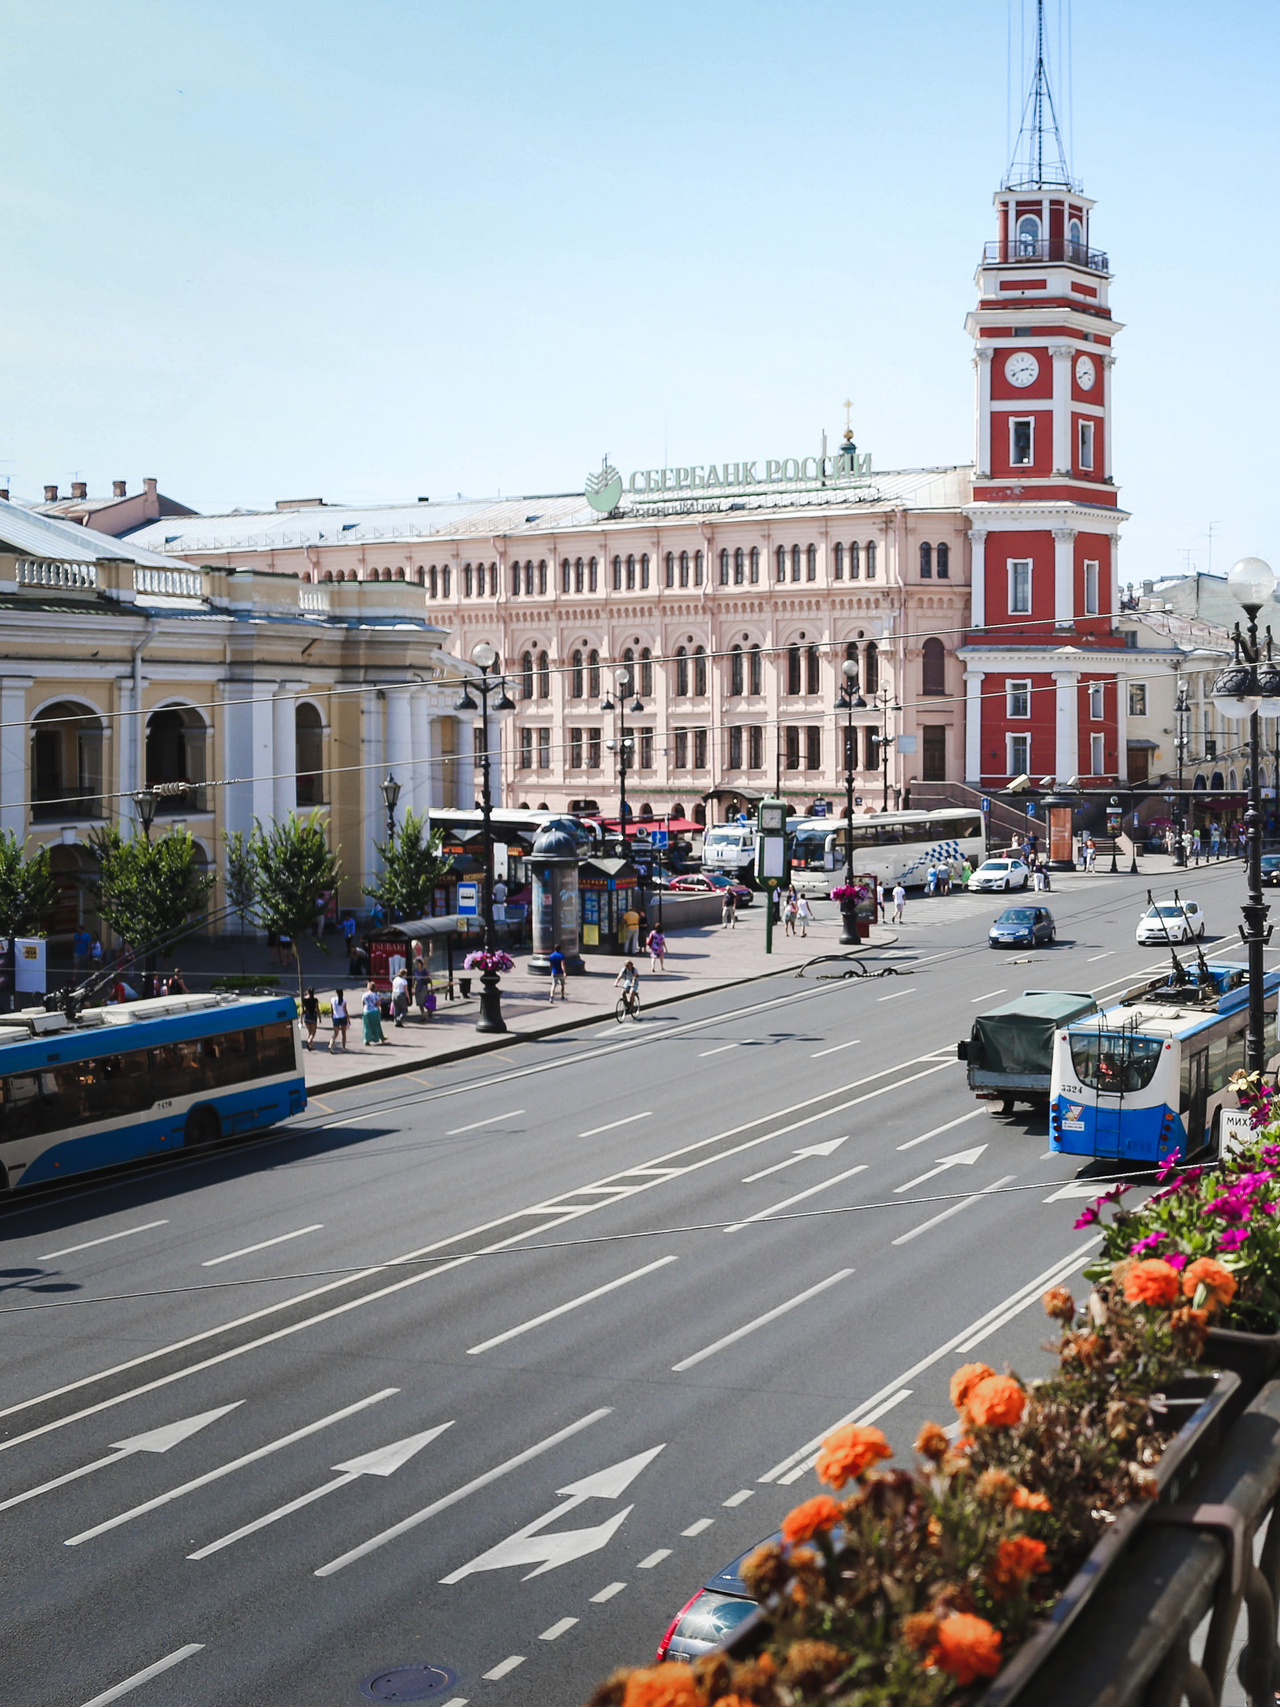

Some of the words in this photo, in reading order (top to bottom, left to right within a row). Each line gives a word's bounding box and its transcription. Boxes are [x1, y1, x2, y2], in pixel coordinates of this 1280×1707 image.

[629, 461, 757, 494] СБЕРБАНК
[765, 453, 872, 484] РОССИИ
[371, 942, 406, 951] TSUBAKI
